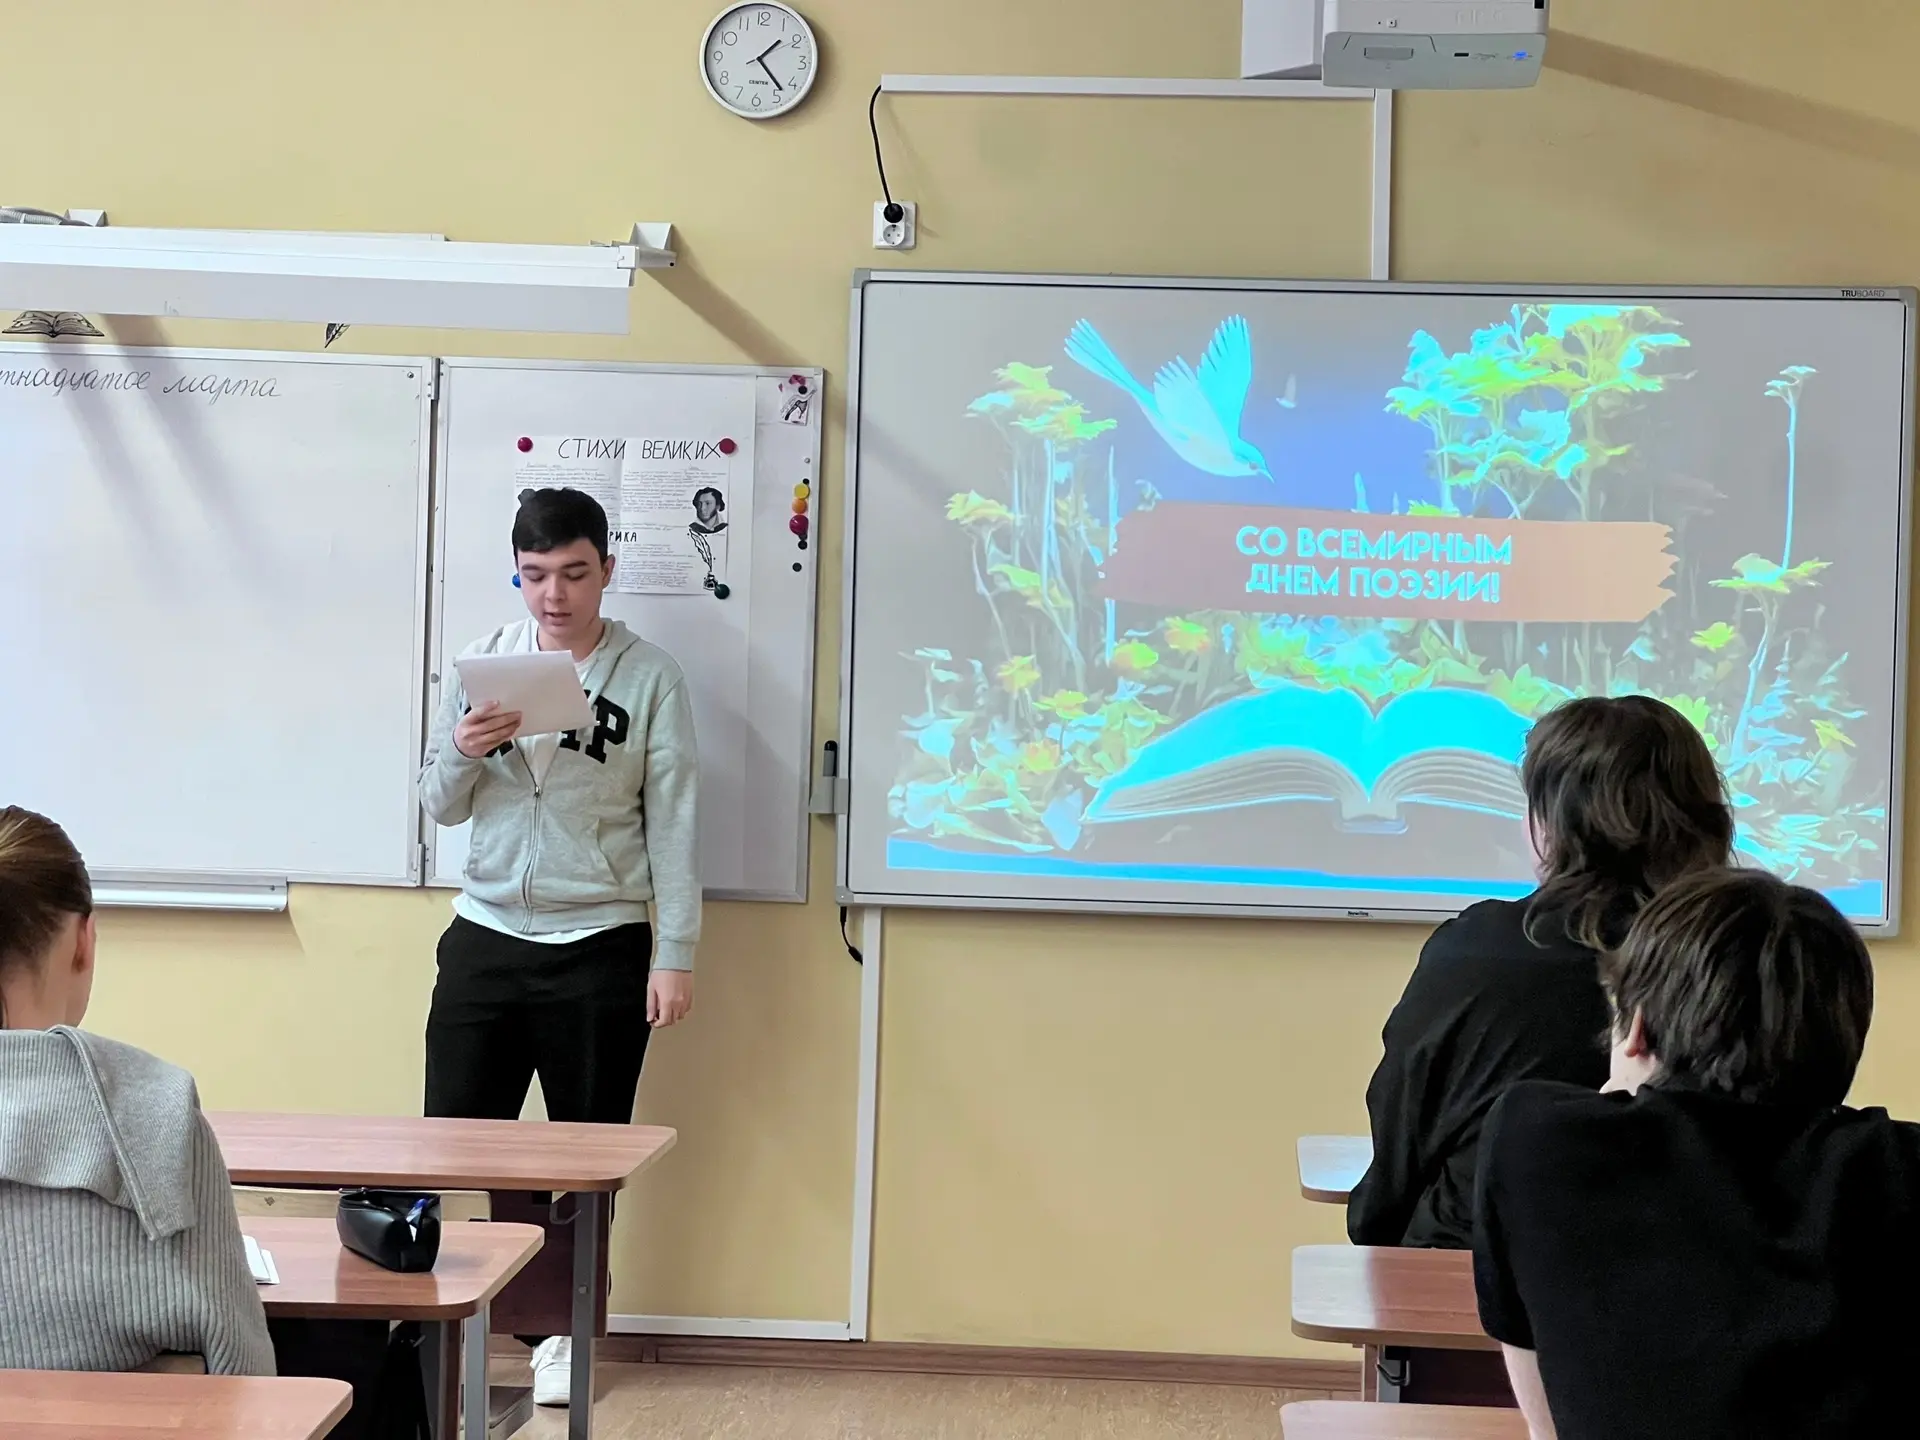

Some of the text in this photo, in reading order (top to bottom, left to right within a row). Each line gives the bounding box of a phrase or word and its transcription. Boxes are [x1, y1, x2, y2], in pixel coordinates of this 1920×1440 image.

[739, 16, 750, 31] 11
[757, 11, 771, 26] 12
[721, 31, 738, 46] 10
[791, 33, 802, 49] 2
[713, 50, 723, 65] 9
[797, 55, 807, 70] 3
[719, 70, 729, 86] 8
[787, 75, 797, 91] 4
[734, 85, 744, 100] 7
[751, 92, 762, 107] 6
[772, 88, 782, 104] 5
[1841, 289, 1885, 297] TRUBOARD
[162, 371, 282, 405] марта
[558, 438, 722, 460] СТИХИ ВЕЛИКИХ
[1235, 525, 1513, 565] СО ВСЕМИРНЫМ
[1245, 563, 1501, 603] ДНЕМ ПОЭЗИИ!
